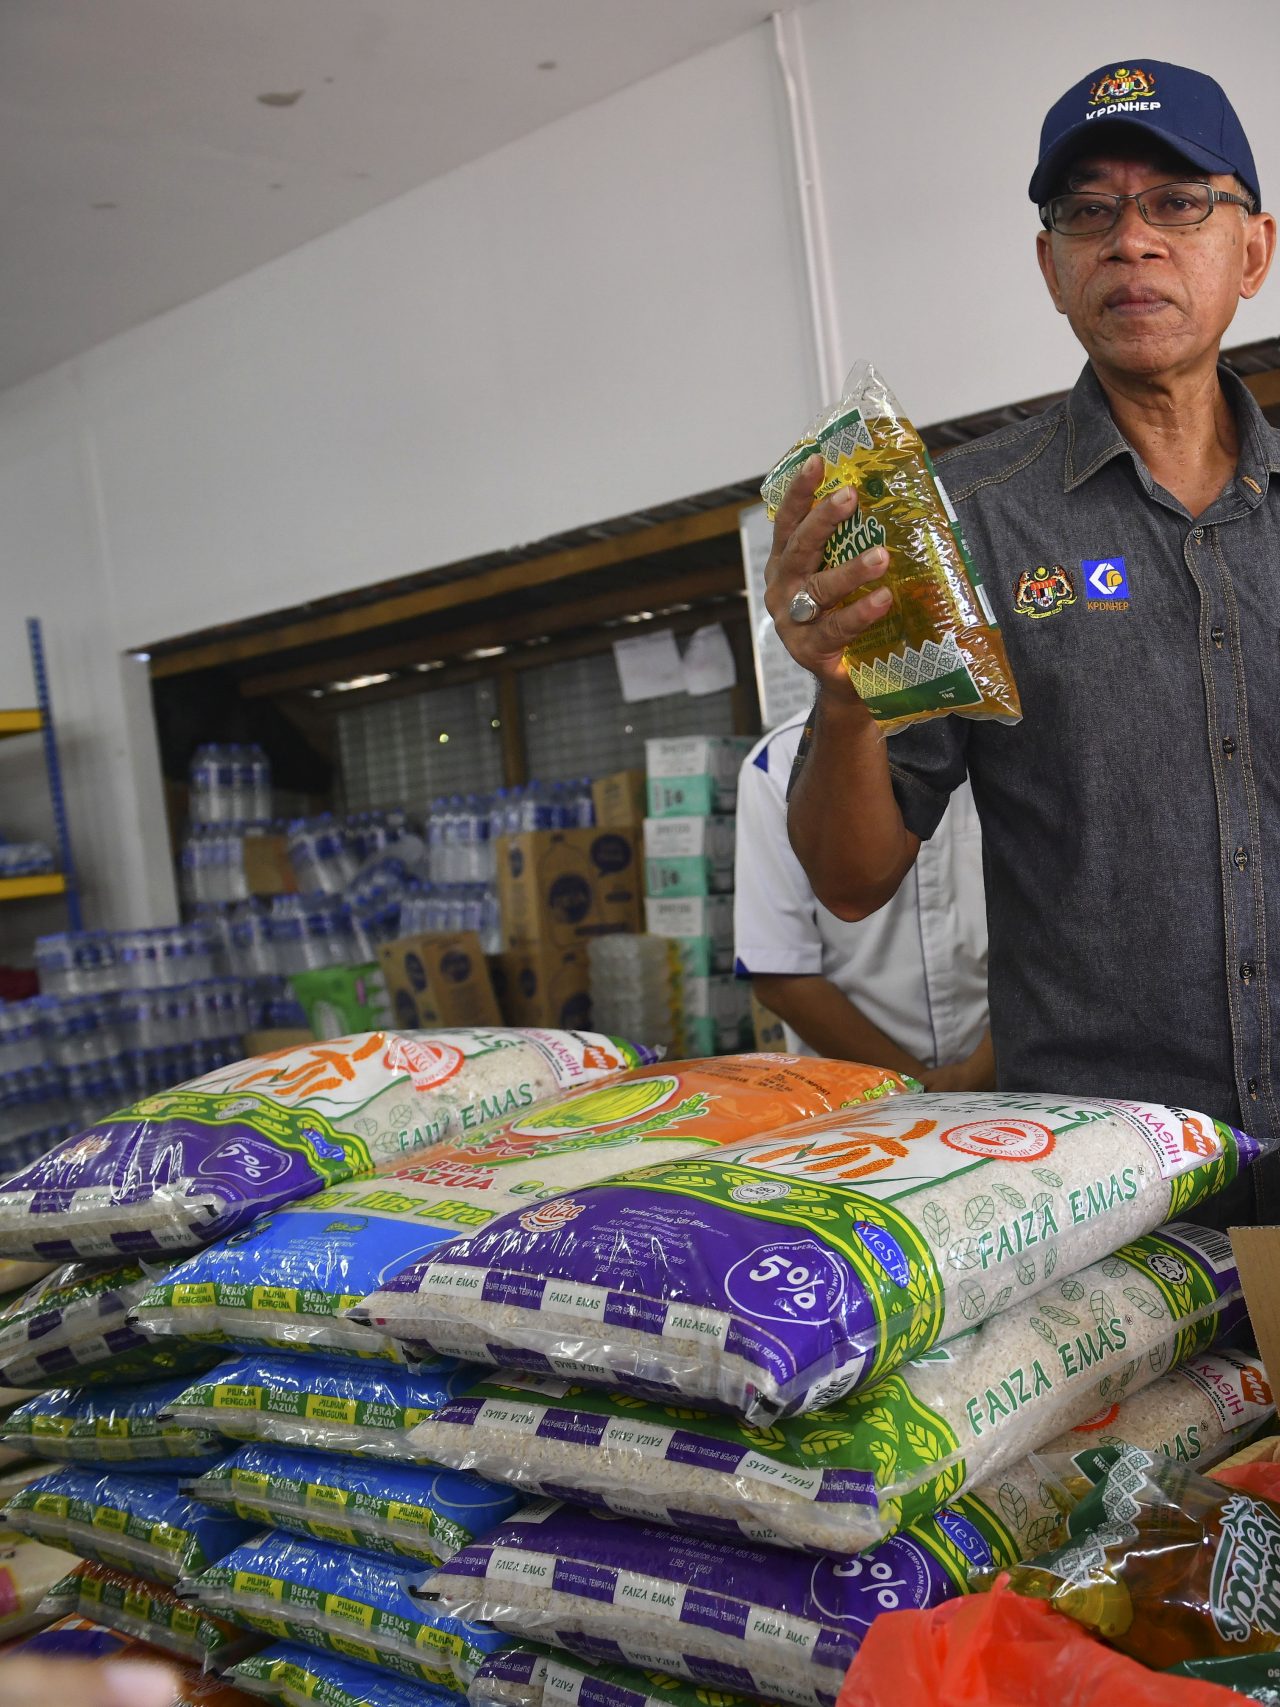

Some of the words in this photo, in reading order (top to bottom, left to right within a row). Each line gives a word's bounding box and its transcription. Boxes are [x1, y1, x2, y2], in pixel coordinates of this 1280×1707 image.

[1086, 101, 1161, 120] KPDNHEP
[1087, 602, 1129, 612] KPDNHEP
[459, 1083, 534, 1130] EMAS
[1140, 1112, 1182, 1163] KASIH
[216, 1143, 262, 1178] 5%
[430, 1159, 500, 1175] BERAS
[386, 1165, 496, 1191] SAZUA
[414, 1200, 497, 1227] Bra
[675, 1216, 690, 1226] Sdn
[976, 1202, 1060, 1270] FAIZA
[1068, 1168, 1138, 1225] EMAS
[762, 1244, 790, 1254] SUPER
[428, 1274, 453, 1286] FAIZA
[456, 1276, 479, 1289] EMAS
[748, 1253, 825, 1309] 5%
[220, 1284, 247, 1296] BERAS
[219, 1295, 247, 1307] SAZUA
[257, 1299, 291, 1310] PENGGUNA
[304, 1292, 332, 1305] BERAS
[549, 1292, 572, 1304] FAIZA
[575, 1296, 600, 1310] EMAS
[302, 1303, 333, 1315] SAZUA
[671, 1316, 698, 1330] FAIZA
[698, 1322, 722, 1337] EMAS
[761, 1346, 789, 1380] TEMPATAN
[966, 1359, 1053, 1437] FAIZA
[1057, 1318, 1127, 1379] EMAS
[269, 1391, 300, 1403] BERAS
[1199, 1363, 1245, 1416] KASIH
[267, 1402, 298, 1414] SAZUA
[312, 1409, 348, 1421] PENGGUNA
[366, 1403, 398, 1417] BERAS
[482, 1409, 508, 1421] EMAS
[362, 1414, 397, 1429] SAZUA
[510, 1412, 536, 1425] FAIZA
[608, 1429, 634, 1442] EMAS
[636, 1434, 664, 1447] FAIZA
[670, 1441, 699, 1455] TEMPATAN
[698, 1447, 721, 1460] SPESIAL
[720, 1450, 741, 1463] SUPER
[746, 1459, 780, 1477] EMAS
[780, 1471, 816, 1490] FAIZA
[397, 1506, 424, 1519] PILIHAN
[751, 1529, 777, 1539] FAIZ
[495, 1559, 519, 1572] FAIZA
[522, 1564, 548, 1577] EMAS
[669, 1558, 685, 1569] LBB
[903, 1547, 925, 1585] TEMPATAN
[568, 1573, 588, 1586] SPESIAL
[588, 1577, 615, 1592] TEMPATAN
[290, 1584, 320, 1601] BERAS
[622, 1586, 648, 1600] FAIZA
[651, 1592, 677, 1607] EMAS
[336, 1600, 365, 1615] PILIHAN
[753, 1621, 781, 1637] FAIZA
[785, 1628, 810, 1647] EMAS
[511, 1662, 531, 1674] SUPER
[550, 1676, 574, 1693] FAIZA
